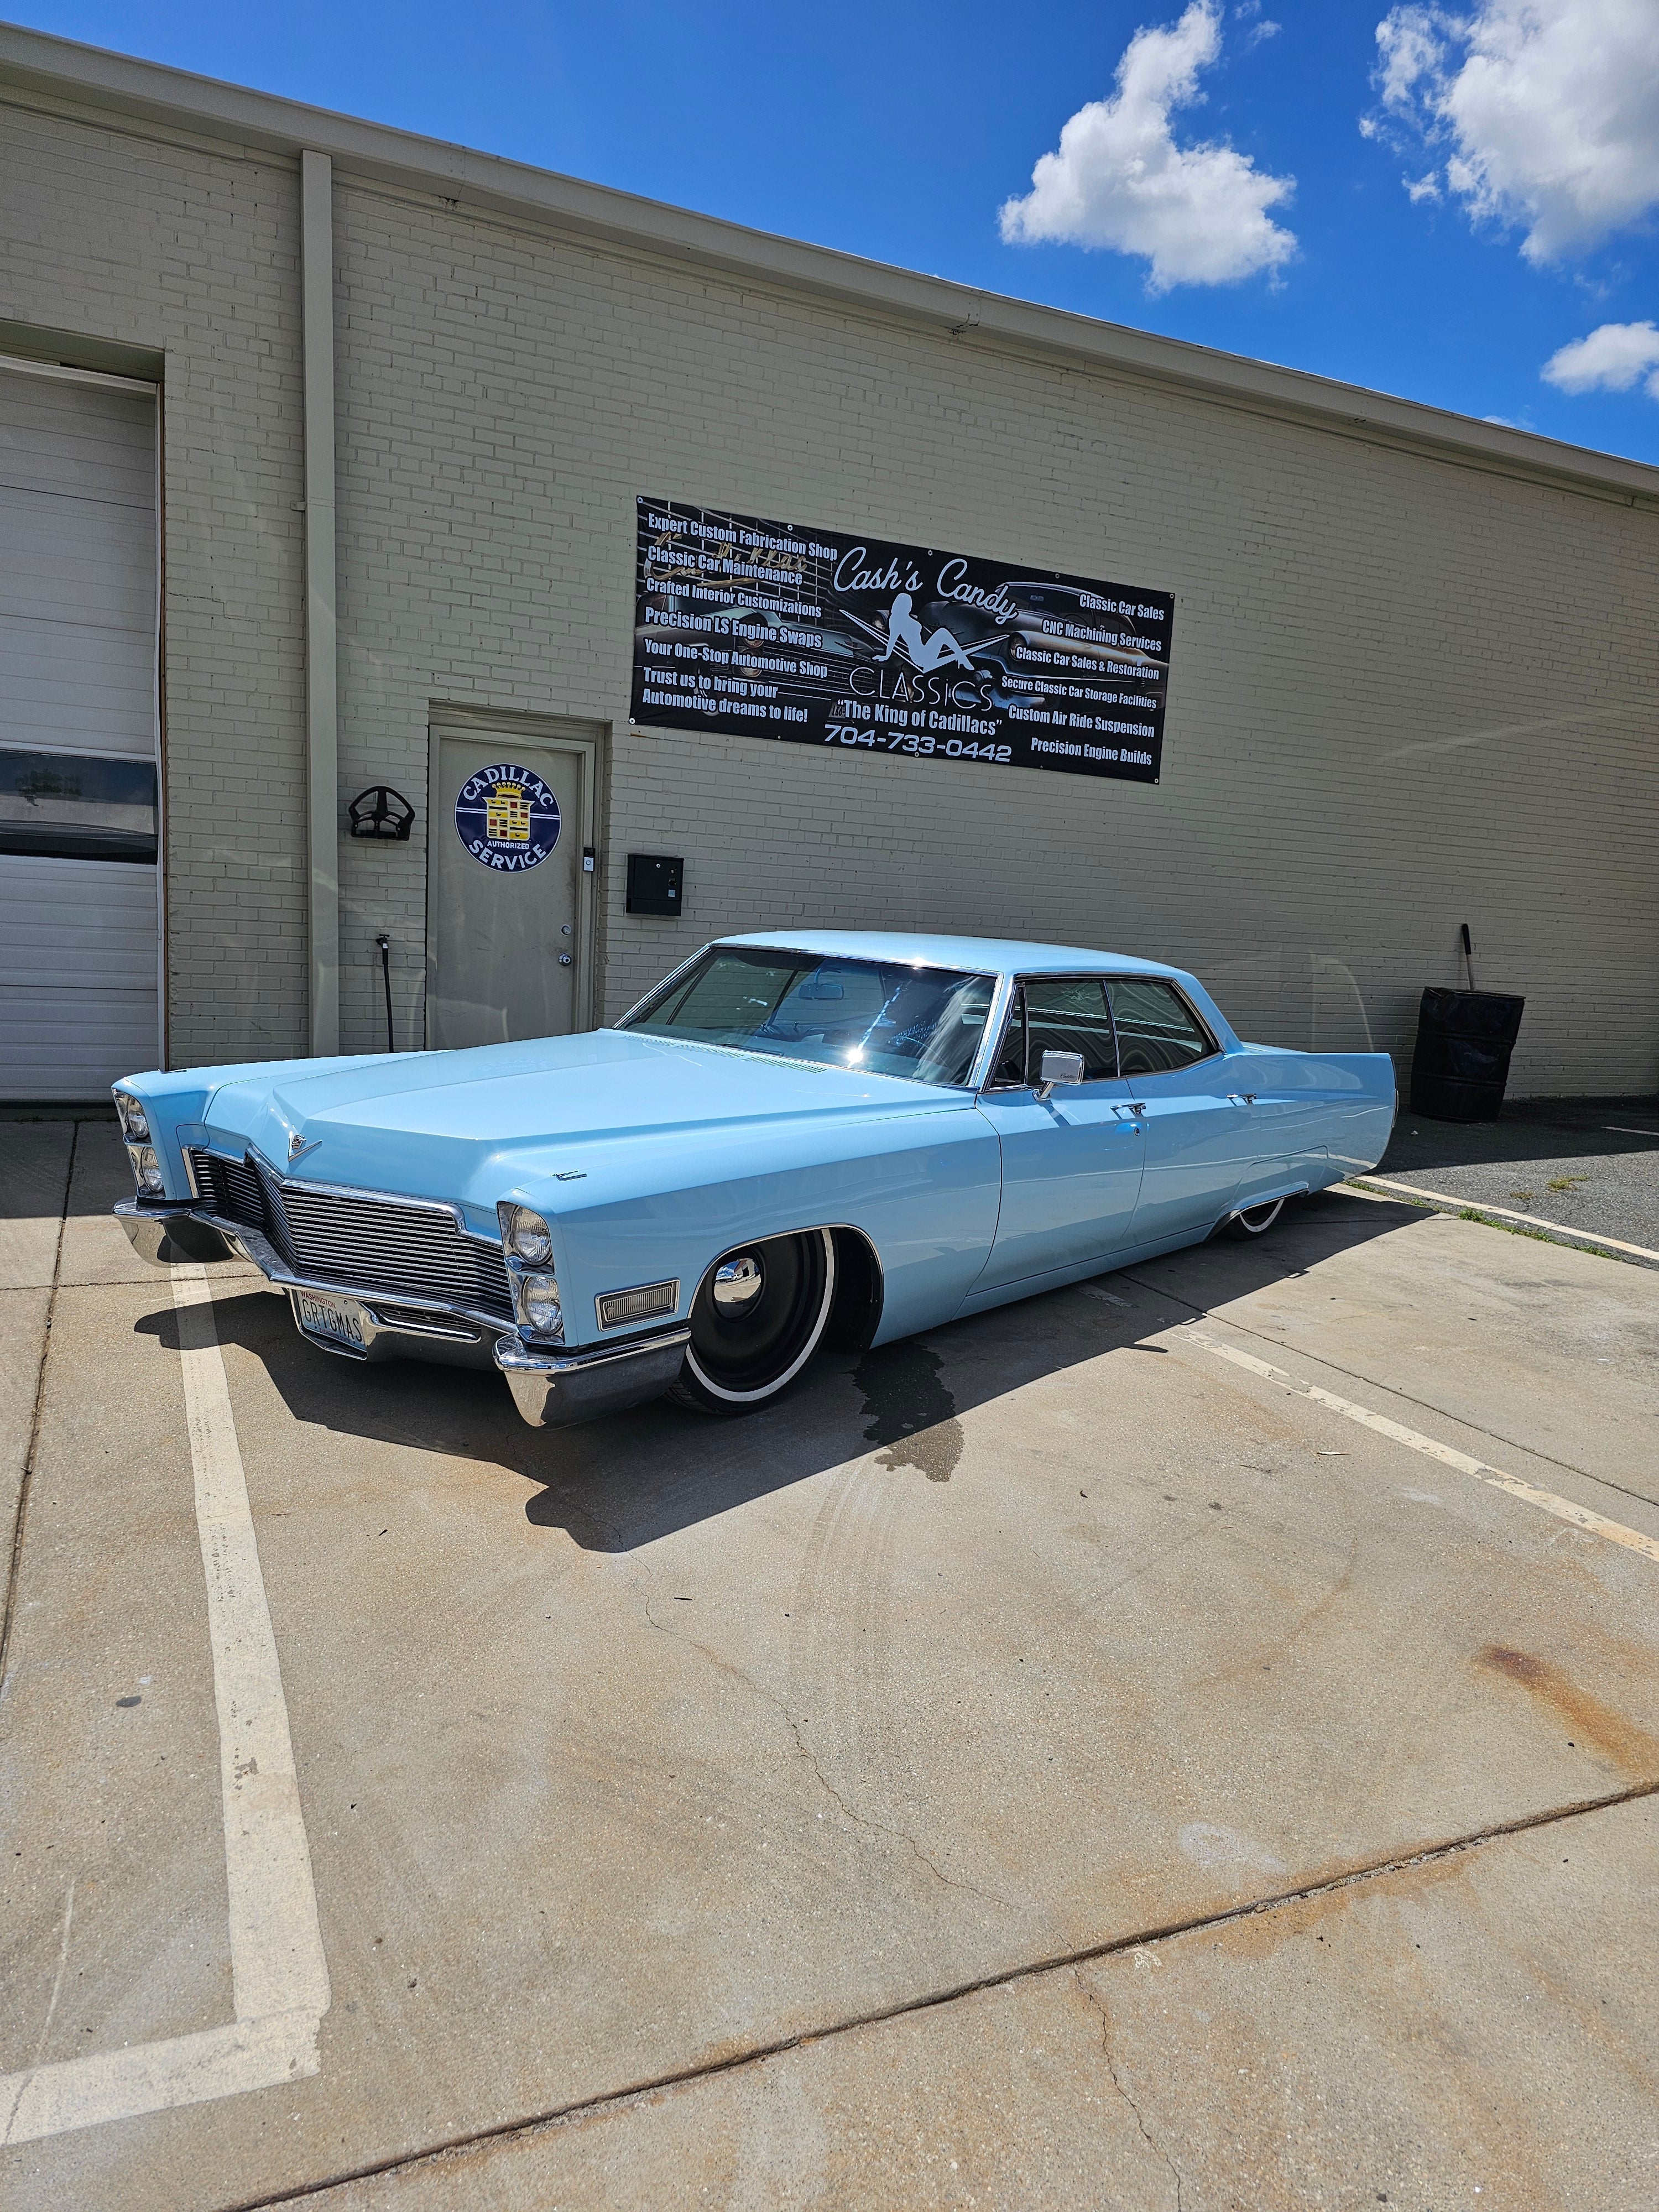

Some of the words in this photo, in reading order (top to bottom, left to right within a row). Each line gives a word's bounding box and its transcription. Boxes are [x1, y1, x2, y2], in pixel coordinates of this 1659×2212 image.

[649, 513, 687, 535] Expert
[690, 521, 737, 543] Custom
[739, 531, 806, 554] Fabrication
[809, 542, 837, 561] Shop
[648, 546, 695, 567] Classic
[698, 555, 719, 571] Car
[723, 562, 802, 585] Maintenance
[646, 578, 689, 596] Crafted
[692, 585, 735, 604] Interior
[738, 594, 822, 617] Customizations
[833, 547, 923, 592] Cash's
[937, 559, 1018, 624] Candy
[1079, 594, 1117, 612] Classic
[1119, 601, 1135, 615] Car
[1138, 604, 1164, 620] Sales
[645, 607, 712, 632] Precision
[715, 617, 729, 634] LS
[733, 621, 776, 640] Engine
[780, 628, 822, 648] Swaps
[1042, 620, 1063, 635] CNC
[1066, 624, 1118, 646] Machining
[1120, 635, 1161, 651] Services
[645, 639, 672, 655] Your
[675, 646, 728, 664] One-Stop
[732, 654, 797, 672] Automotive
[800, 661, 827, 678] Shop
[1016, 646, 1051, 662] Classic
[1053, 654, 1070, 667] Car
[1072, 658, 1097, 671] Sales
[1099, 661, 1105, 671] &
[1107, 661, 1159, 680] Restoration
[644, 667, 677, 685] Trust
[680, 674, 696, 688] us
[699, 676, 710, 690] to
[714, 677, 748, 695] bring
[750, 682, 778, 698] your
[1002, 676, 1032, 691] Secure
[1035, 681, 1067, 696] Classic
[1069, 686, 1083, 698] Car
[1085, 688, 1117, 703] Storage
[1119, 693, 1156, 708] Facilities
[643, 689, 716, 711] Automotive
[719, 698, 766, 717] dreams
[769, 705, 781, 719] to
[784, 707, 808, 722] life!
[875, 705, 908, 727] King
[912, 711, 925, 727] of
[1009, 705, 1050, 723] Custom
[1052, 713, 1067, 726] Air
[1070, 716, 1092, 728] Ride
[1095, 718, 1154, 737] Suspension
[824, 724, 1012, 762] 704-733-0442
[1031, 738, 1081, 756] Precision
[1084, 745, 1118, 761] Engine
[1120, 749, 1151, 765] Builds
[463, 766, 554, 807] CADILLAC
[469, 840, 546, 870] SERVICE
[487, 841, 530, 849] AUTHORIZED
[300, 1291, 336, 1308] WASHINGTON
[302, 1299, 362, 1342] GRTGMAS
